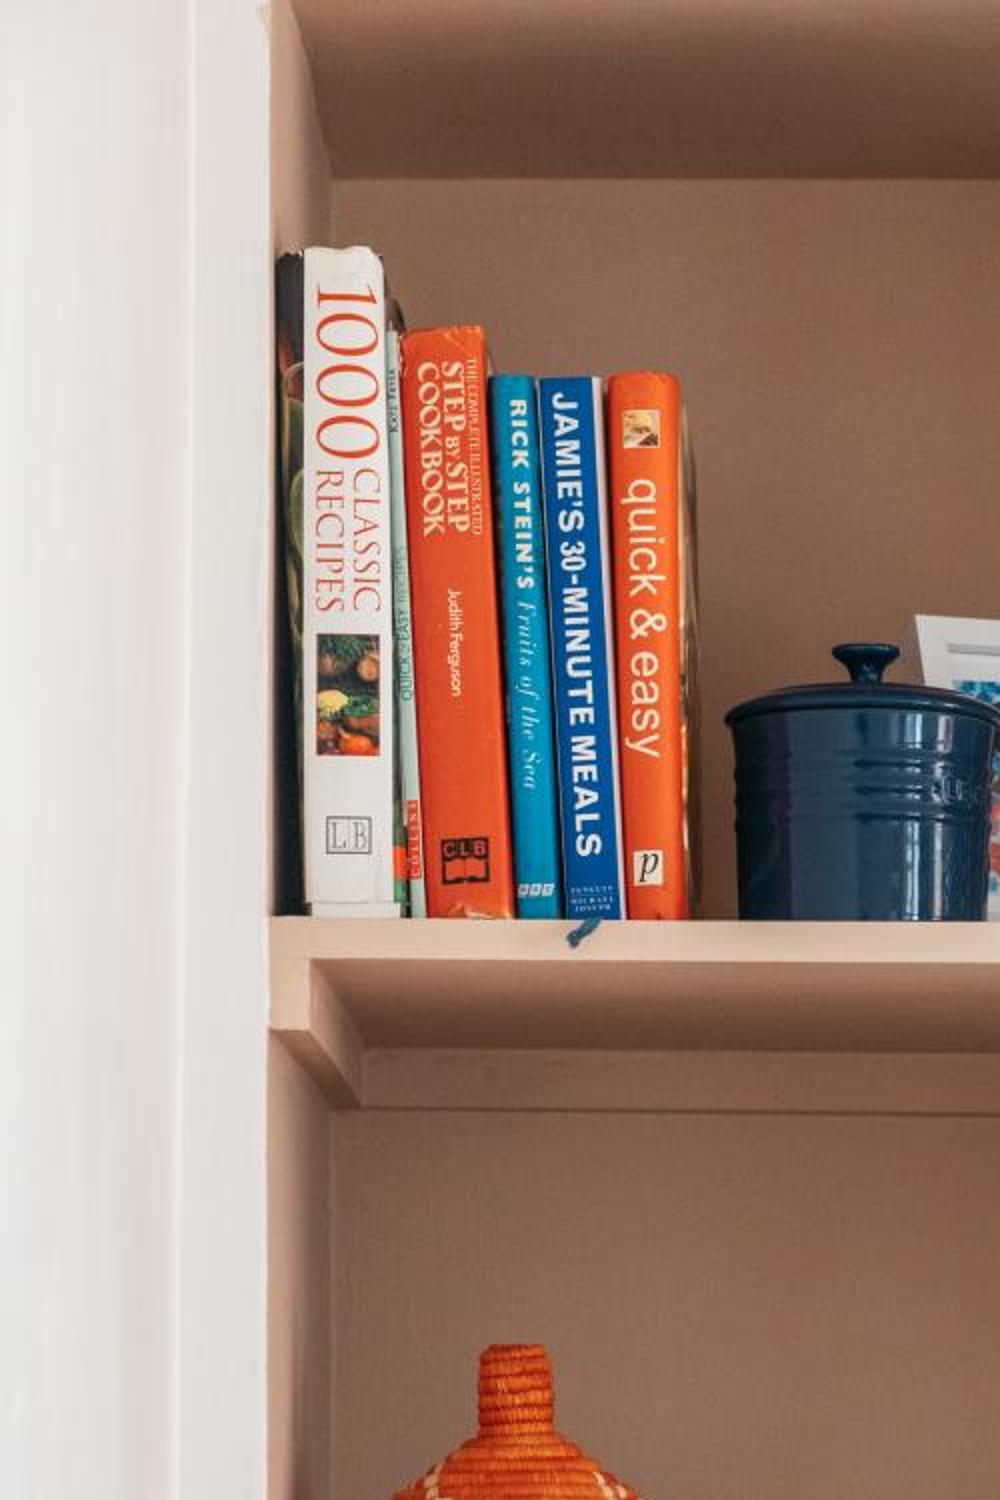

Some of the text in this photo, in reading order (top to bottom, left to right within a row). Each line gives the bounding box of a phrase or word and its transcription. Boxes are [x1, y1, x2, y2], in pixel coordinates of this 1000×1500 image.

[315, 283, 380, 460] 1000
[416, 361, 445, 537] COOKBOOK
[441, 361, 470, 533] STEP BY STEP
[314, 469, 345, 613] RECIPES
[352, 467, 381, 612] CLASSIC
[508, 399, 543, 789] RICK STEIN'S Fruits of the Sea
[551, 391, 602, 857] JAMIE'S 30-MINUTE MEALS
[620, 478, 668, 759] quick & easy
[446, 588, 463, 697] Judith Ferguson
[442, 839, 489, 858] CLB
[640, 852, 659, 883] p
